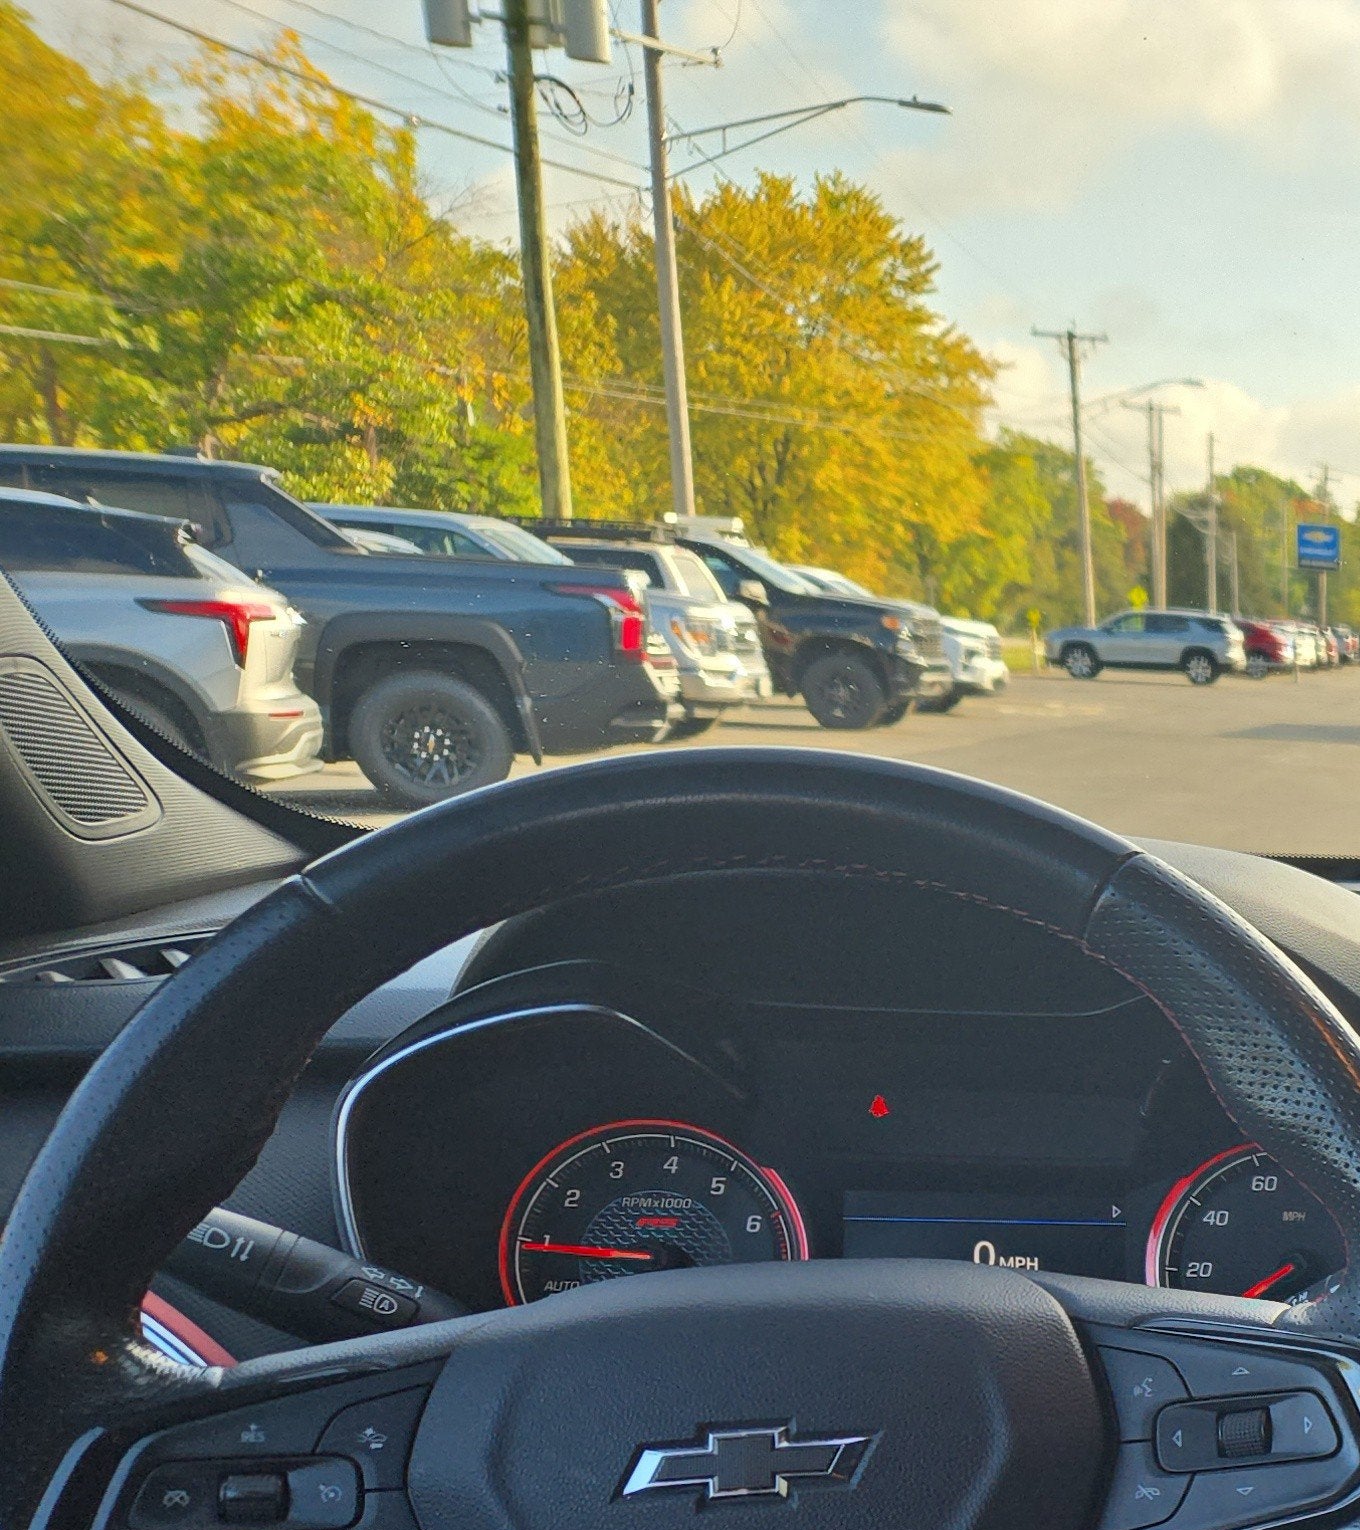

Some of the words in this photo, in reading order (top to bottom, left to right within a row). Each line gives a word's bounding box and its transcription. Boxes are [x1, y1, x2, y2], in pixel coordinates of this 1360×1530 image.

[609, 1161, 625, 1179] 3
[663, 1156, 679, 1174] 4
[710, 1176, 727, 1195] 5
[1251, 1175, 1278, 1192] 60
[564, 1188, 581, 1208] 2
[745, 1215, 762, 1233] 6
[1203, 1209, 1229, 1227] 40
[973, 1240, 996, 1268] 0
[1000, 1256, 1039, 1271] MPH
[1186, 1261, 1213, 1279] 20
